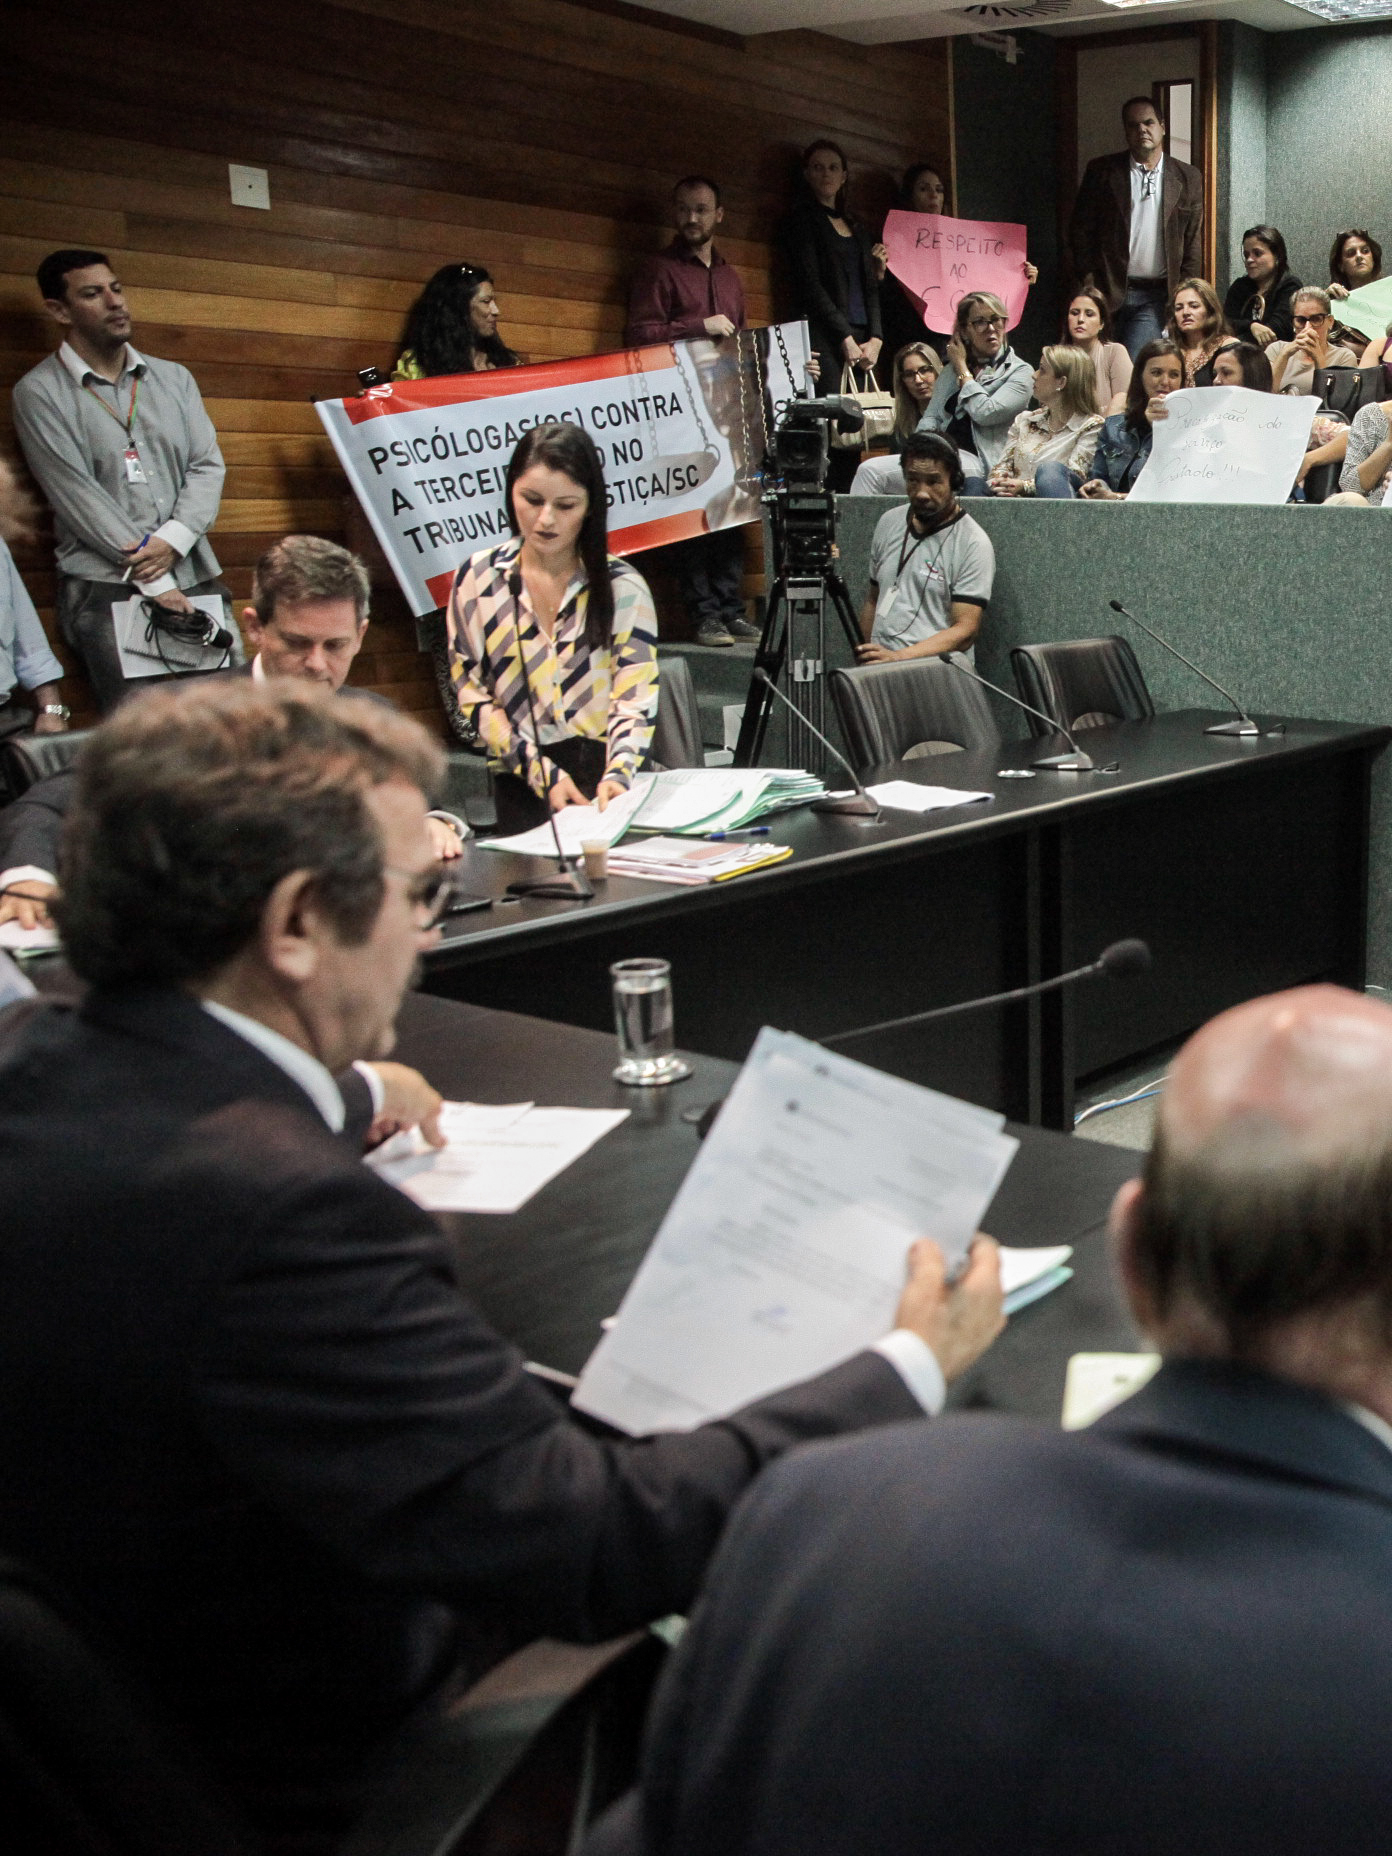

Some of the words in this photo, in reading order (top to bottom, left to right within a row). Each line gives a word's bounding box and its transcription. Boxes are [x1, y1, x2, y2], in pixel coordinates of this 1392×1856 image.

[915, 227, 1005, 257] RESPEITO
[591, 392, 684, 430] CONTRA
[391, 487, 415, 517] A
[612, 438, 644, 467] NO
[403, 507, 512, 554] TRIBUNA
[604, 464, 700, 508] STIÇA/SC
